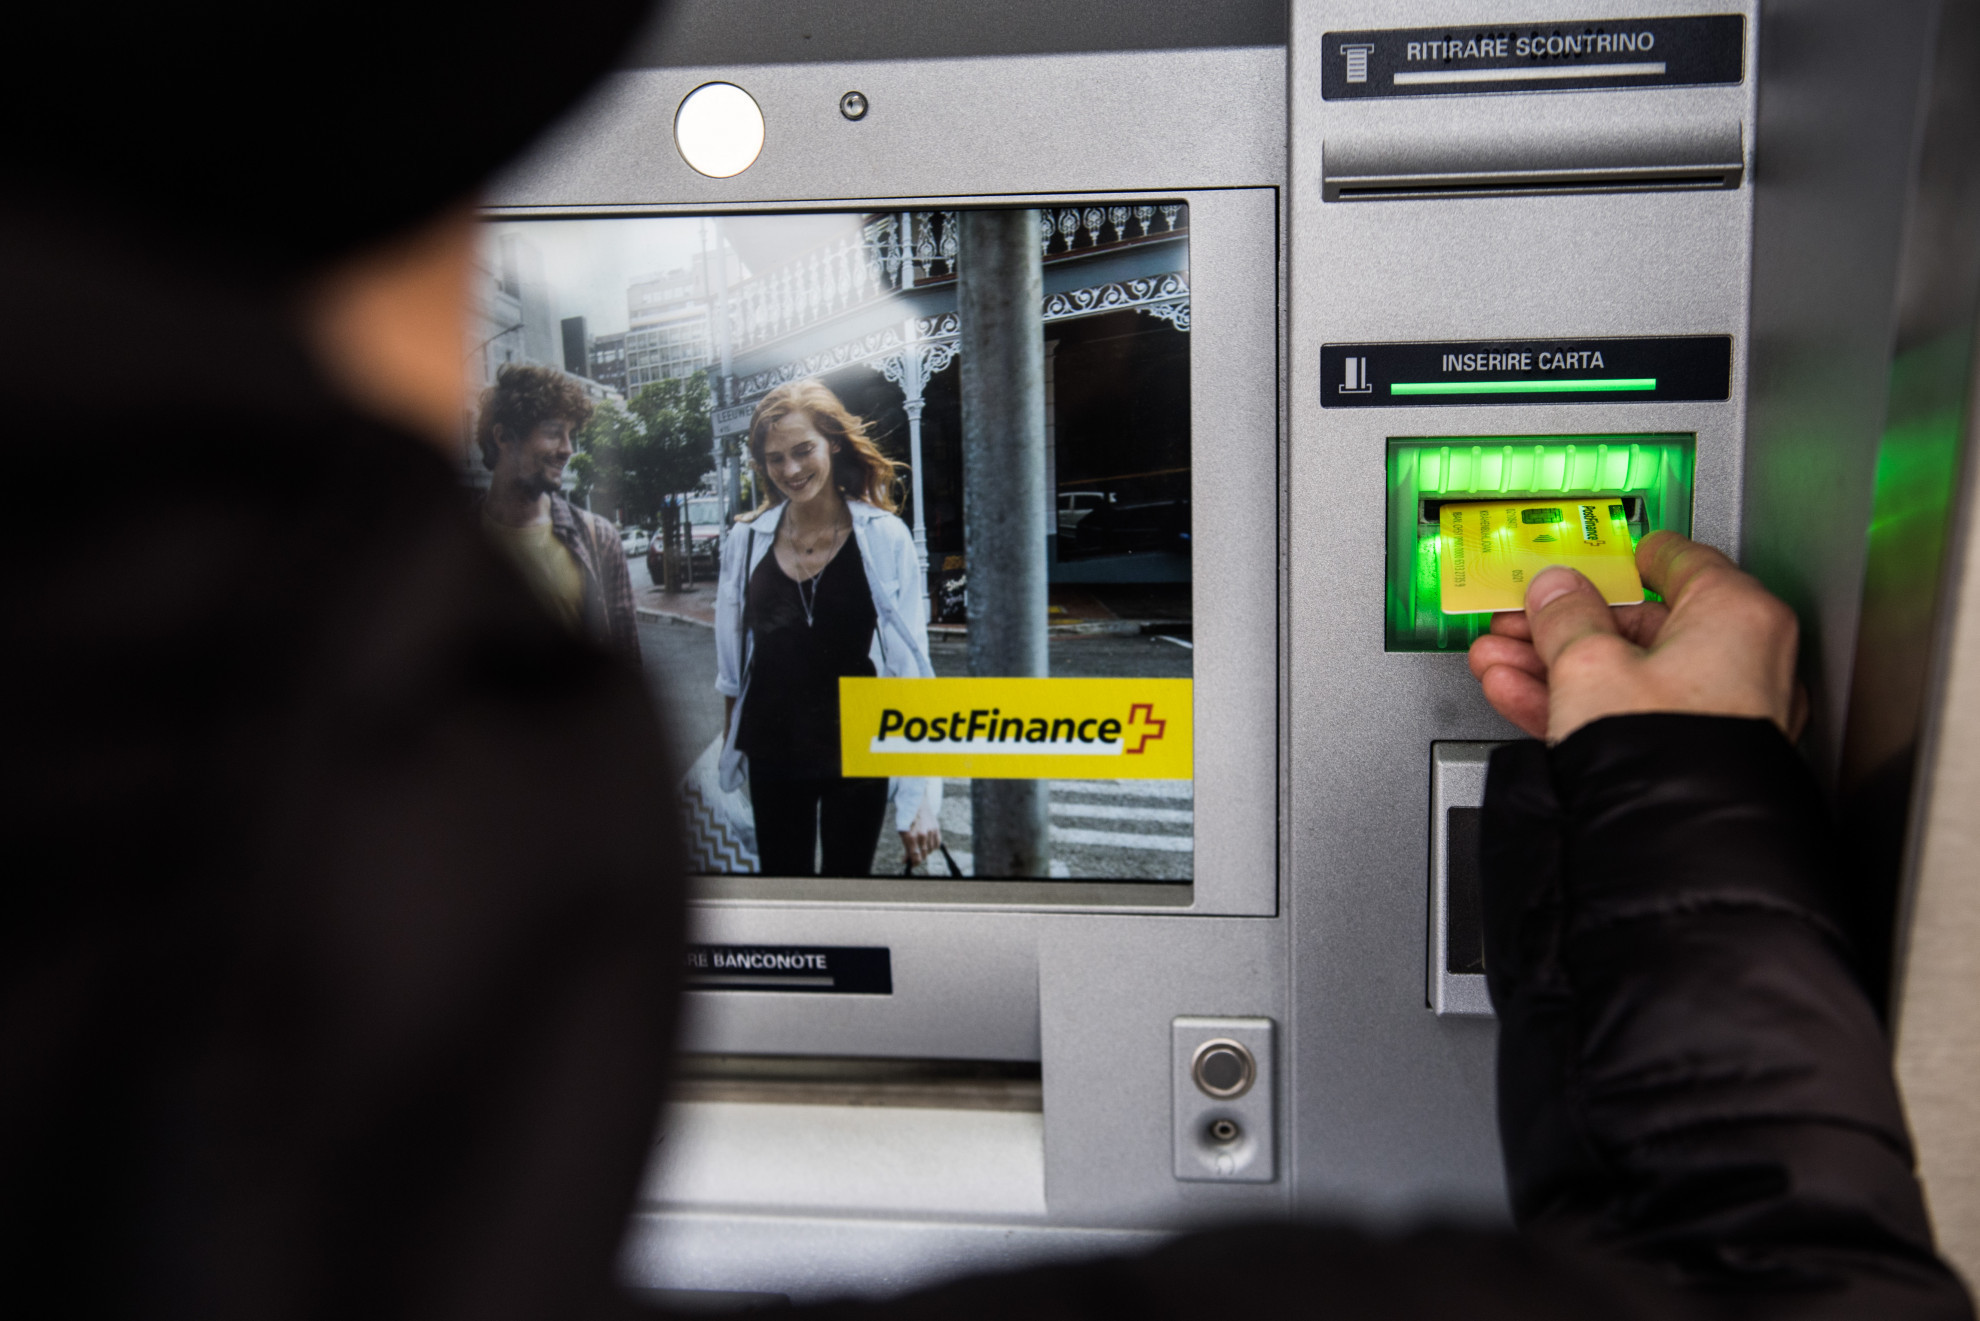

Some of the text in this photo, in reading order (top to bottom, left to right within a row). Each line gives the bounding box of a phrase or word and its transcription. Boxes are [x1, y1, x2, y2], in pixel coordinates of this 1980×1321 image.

[1407, 31, 1655, 61] RITIRARE SCONTRINO
[1441, 351, 1605, 372] INSERIRE CARTA
[1582, 505, 1599, 541] PostFinance
[876, 707, 1122, 744] PostFinance
[713, 953, 827, 969] BANCONOTE
